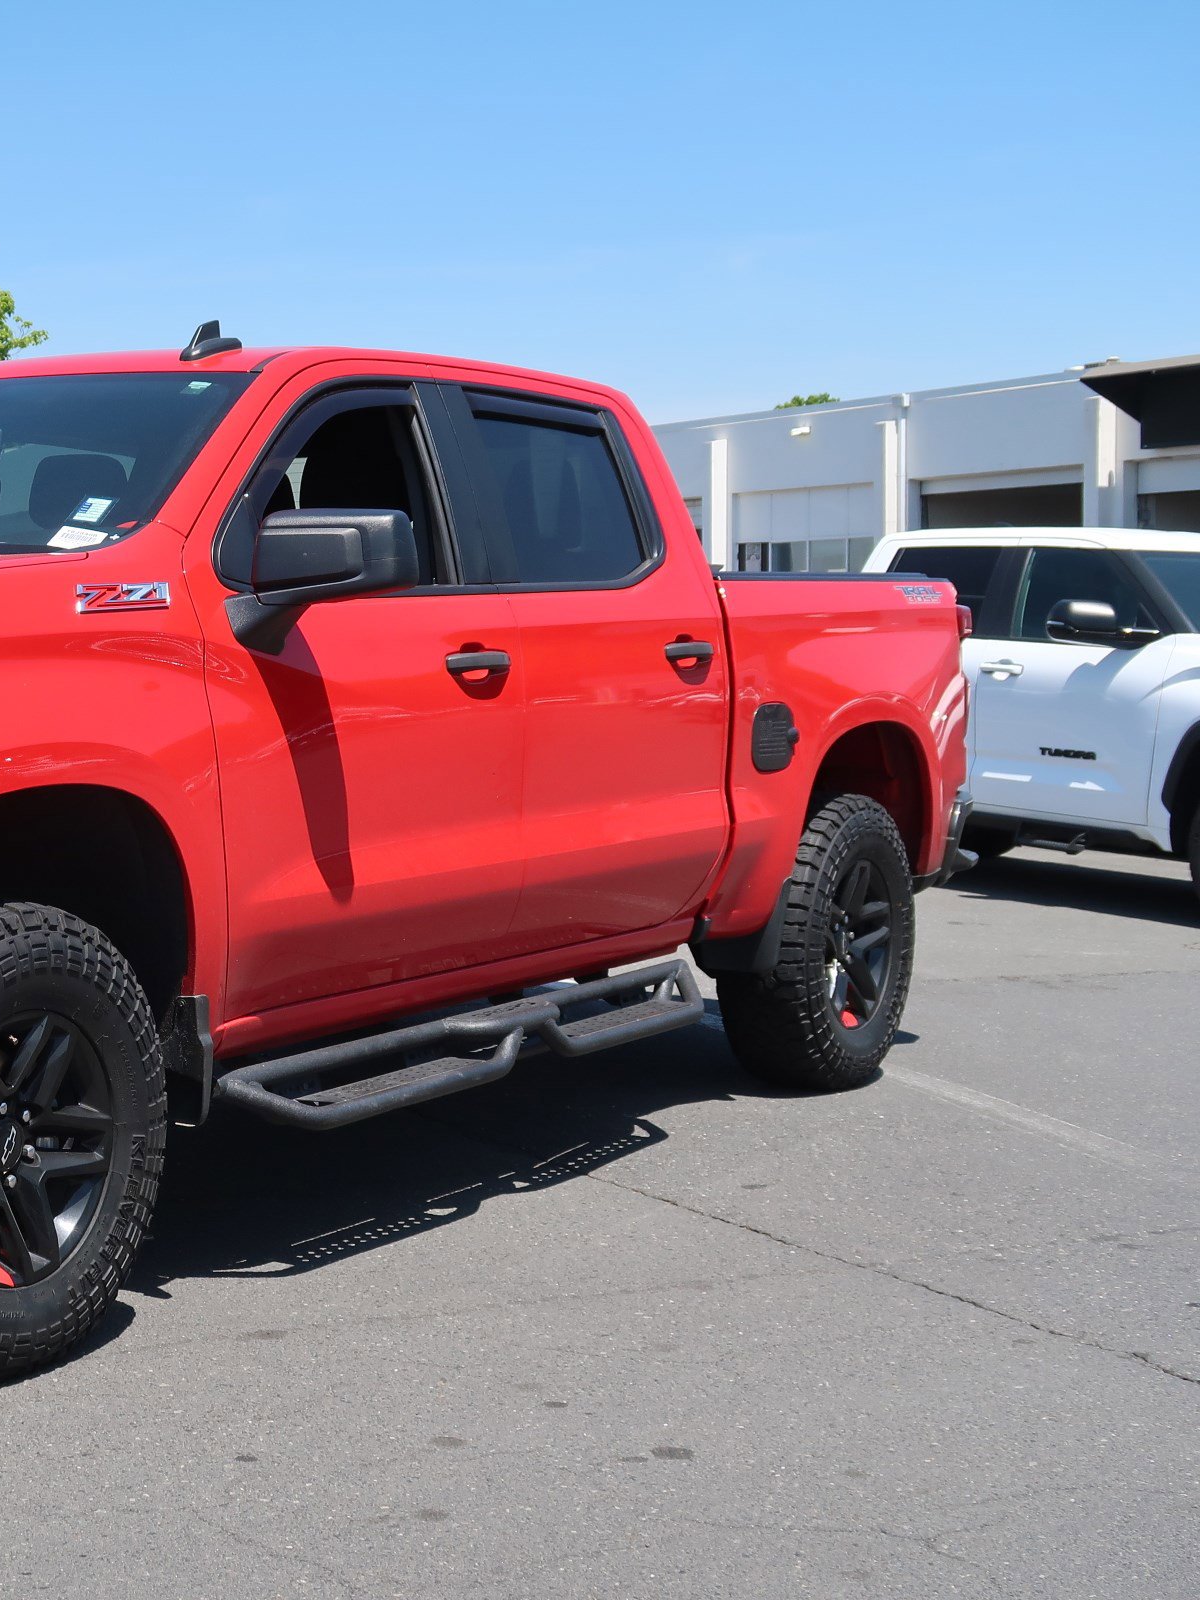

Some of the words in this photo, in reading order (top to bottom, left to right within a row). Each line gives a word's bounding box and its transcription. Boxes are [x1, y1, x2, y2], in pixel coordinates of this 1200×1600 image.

[76, 582, 170, 612] Z71
[895, 585, 943, 597] TRAIL
[906, 595, 942, 604] BOSS
[1039, 746, 1097, 761] TUNDRA
